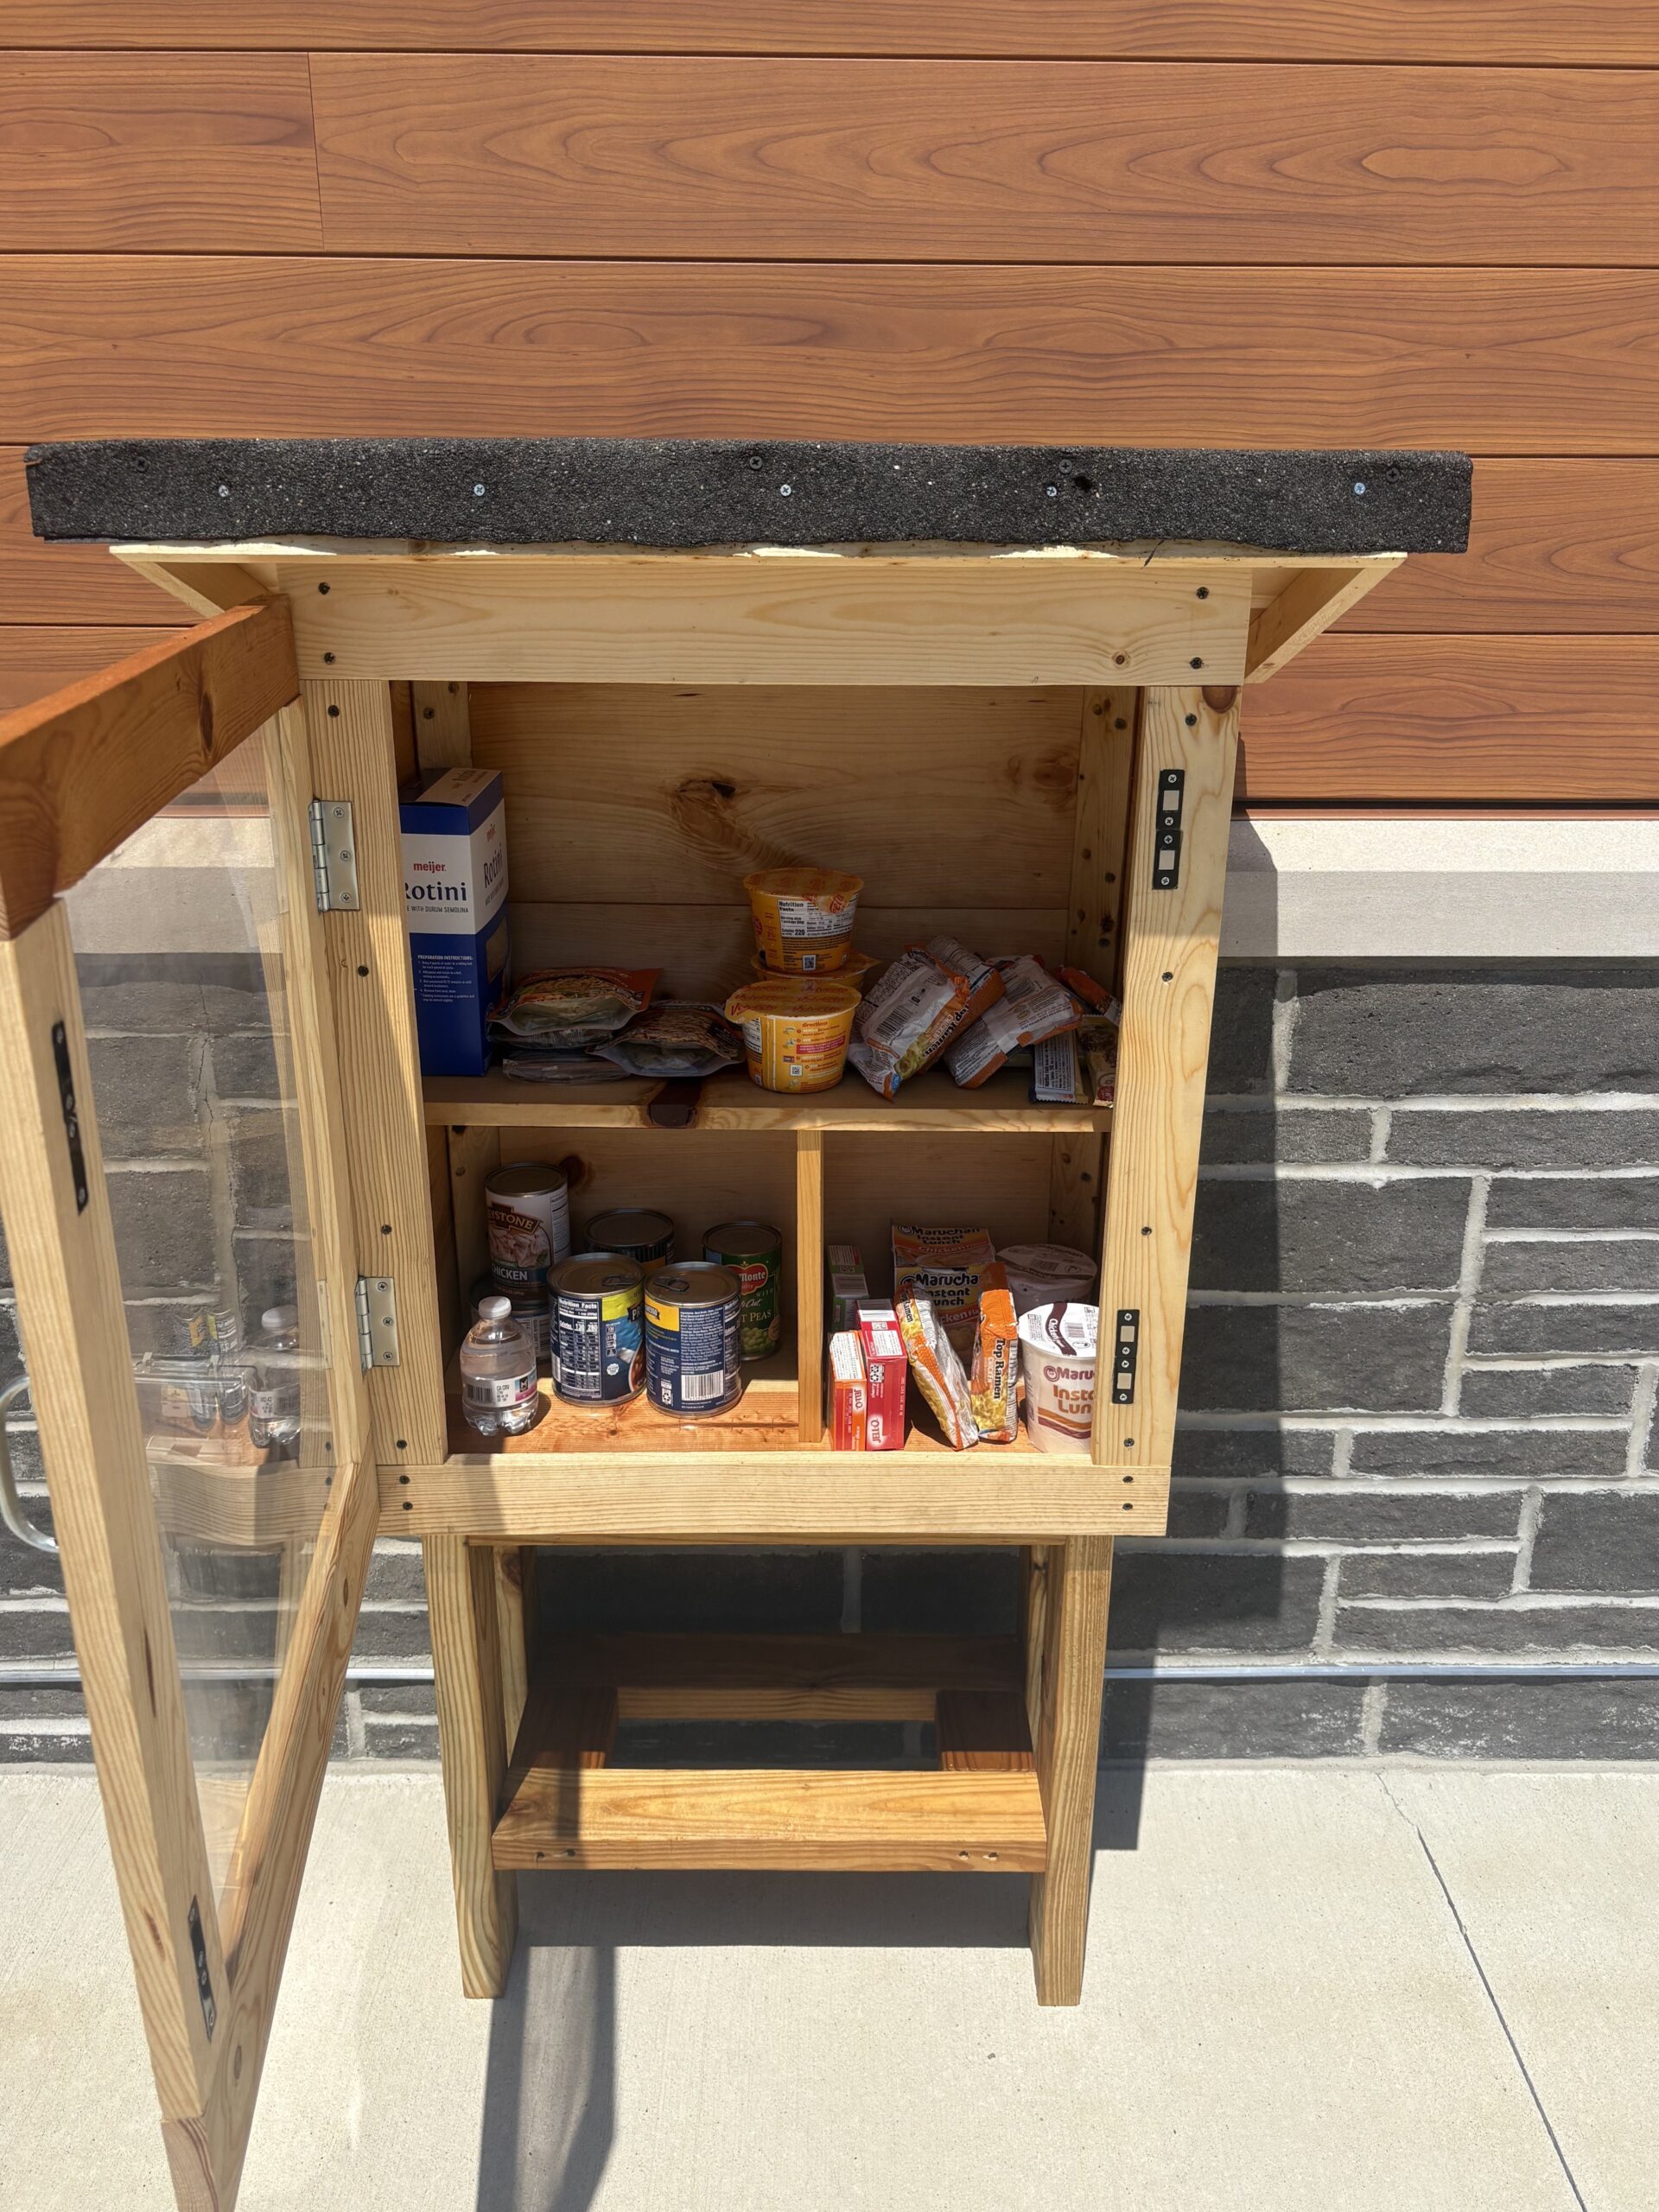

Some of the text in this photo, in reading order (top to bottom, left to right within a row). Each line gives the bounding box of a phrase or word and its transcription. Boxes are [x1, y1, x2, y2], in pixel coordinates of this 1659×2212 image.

[484, 843, 503, 889] Rotini
[490, 1209, 534, 1230] YSTONE
[912, 1225, 980, 1236] Maruchan
[916, 1273, 979, 1287] Marucha
[928, 1287, 970, 1298] nstant
[934, 1297, 964, 1306] unch
[940, 1311, 969, 1323] cken
[993, 1338, 1006, 1400] Top Ramen
[1058, 1367, 1093, 1381] Maru
[1058, 1400, 1090, 1414] Lun
